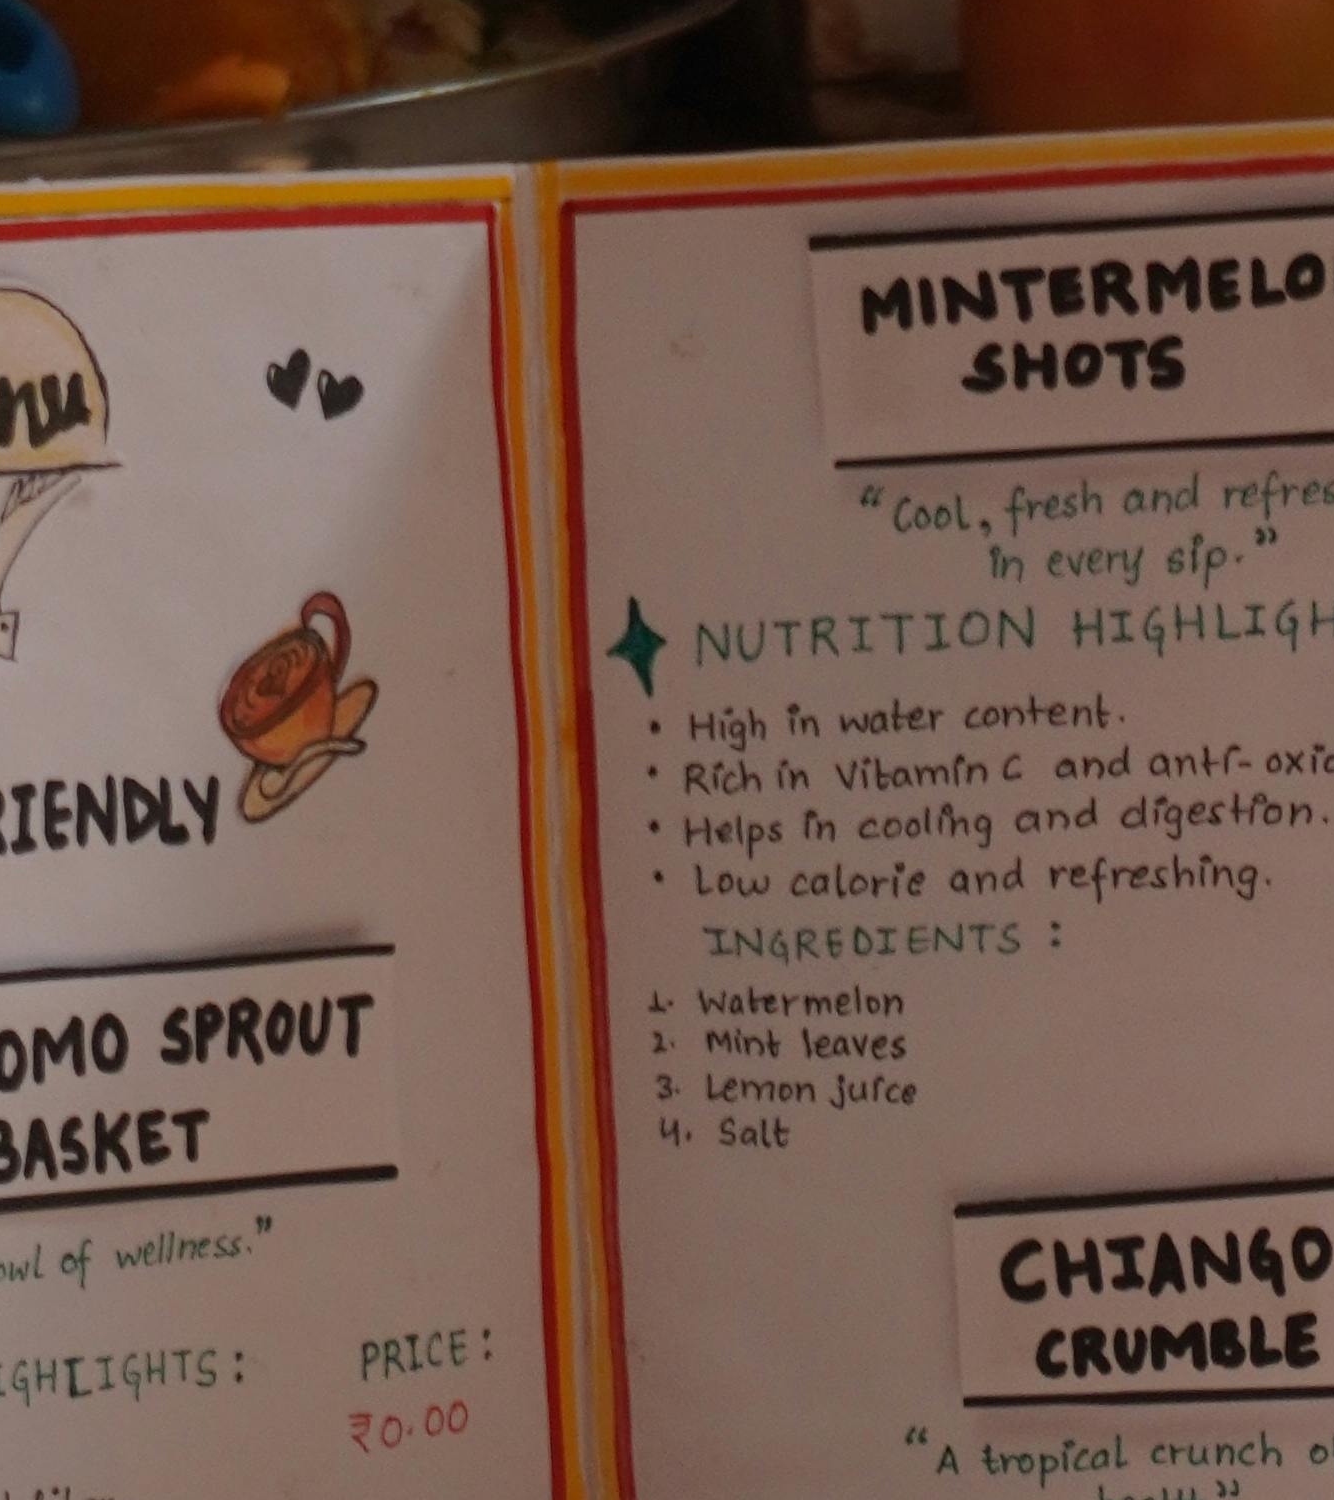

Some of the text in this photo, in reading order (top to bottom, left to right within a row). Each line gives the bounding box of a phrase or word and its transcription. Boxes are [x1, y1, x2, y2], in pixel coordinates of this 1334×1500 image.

[960, 333, 1186, 395] SHOTS
[1004, 479, 1102, 537] fresh
[1123, 471, 1199, 514] and
[989, 544, 1024, 582] in
[1047, 546, 1144, 586] every
[696, 606, 1034, 666] NUTRITION
[689, 692, 1125, 752] High in water content.
[684, 760, 762, 795] Rich
[776, 758, 810, 790] in
[834, 753, 989, 791] Vitamin
[1002, 752, 1023, 781] C
[1054, 744, 1131, 780] and
[684, 791, 1329, 860] Helps in cooling and digestion.
[694, 853, 1271, 905] Low calorie and refreshing.
[159, 991, 375, 1066] SPROUT
[697, 984, 904, 1017] Watermelon
[705, 1027, 907, 1061] Mint leaves
[706, 1073, 917, 1110] Lemon juice
[718, 1116, 790, 1149] Salt
[60, 1238, 92, 1290] of
[999, 1224, 1333, 1304] CHIANGO
[1034, 1310, 1321, 1379] CRUMBLE
[349, 1400, 468, 1453] ₹0.00
[981, 1434, 1127, 1489] tropical
[1150, 1430, 1283, 1467] crunch
